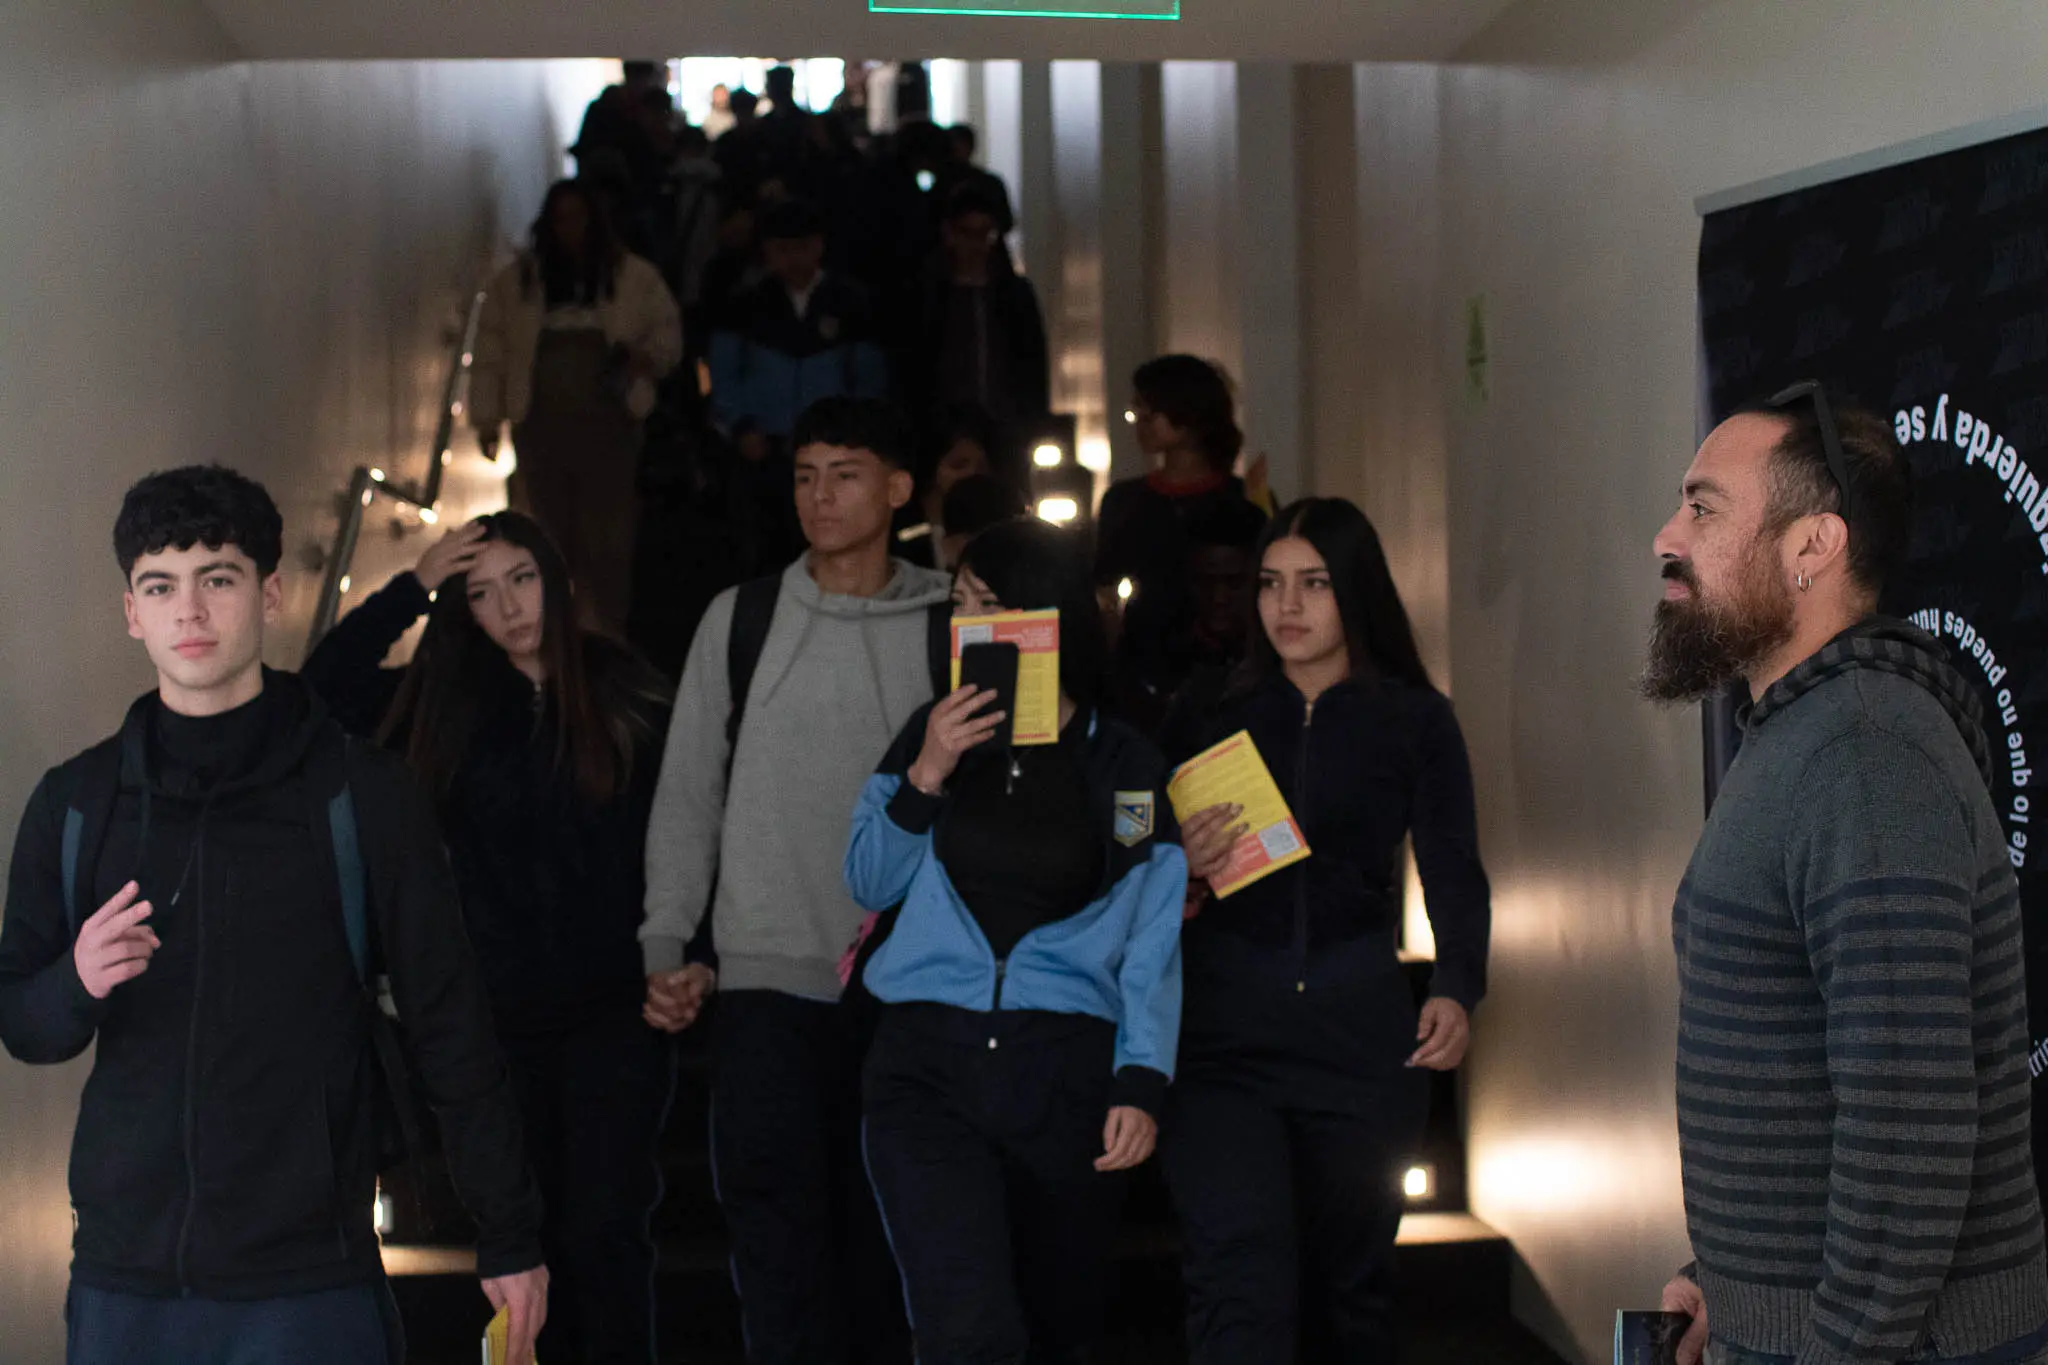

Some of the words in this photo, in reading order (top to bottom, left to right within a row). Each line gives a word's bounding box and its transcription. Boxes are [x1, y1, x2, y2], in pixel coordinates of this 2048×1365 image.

[1931, 393, 1949, 441] y
[1954, 409, 2048, 575] quierda
[1908, 608, 1940, 638] hui
[1944, 611, 2007, 687] puedes
[1997, 688, 2018, 727] no
[2007, 731, 2032, 787] que
[2009, 794, 2030, 823] lo
